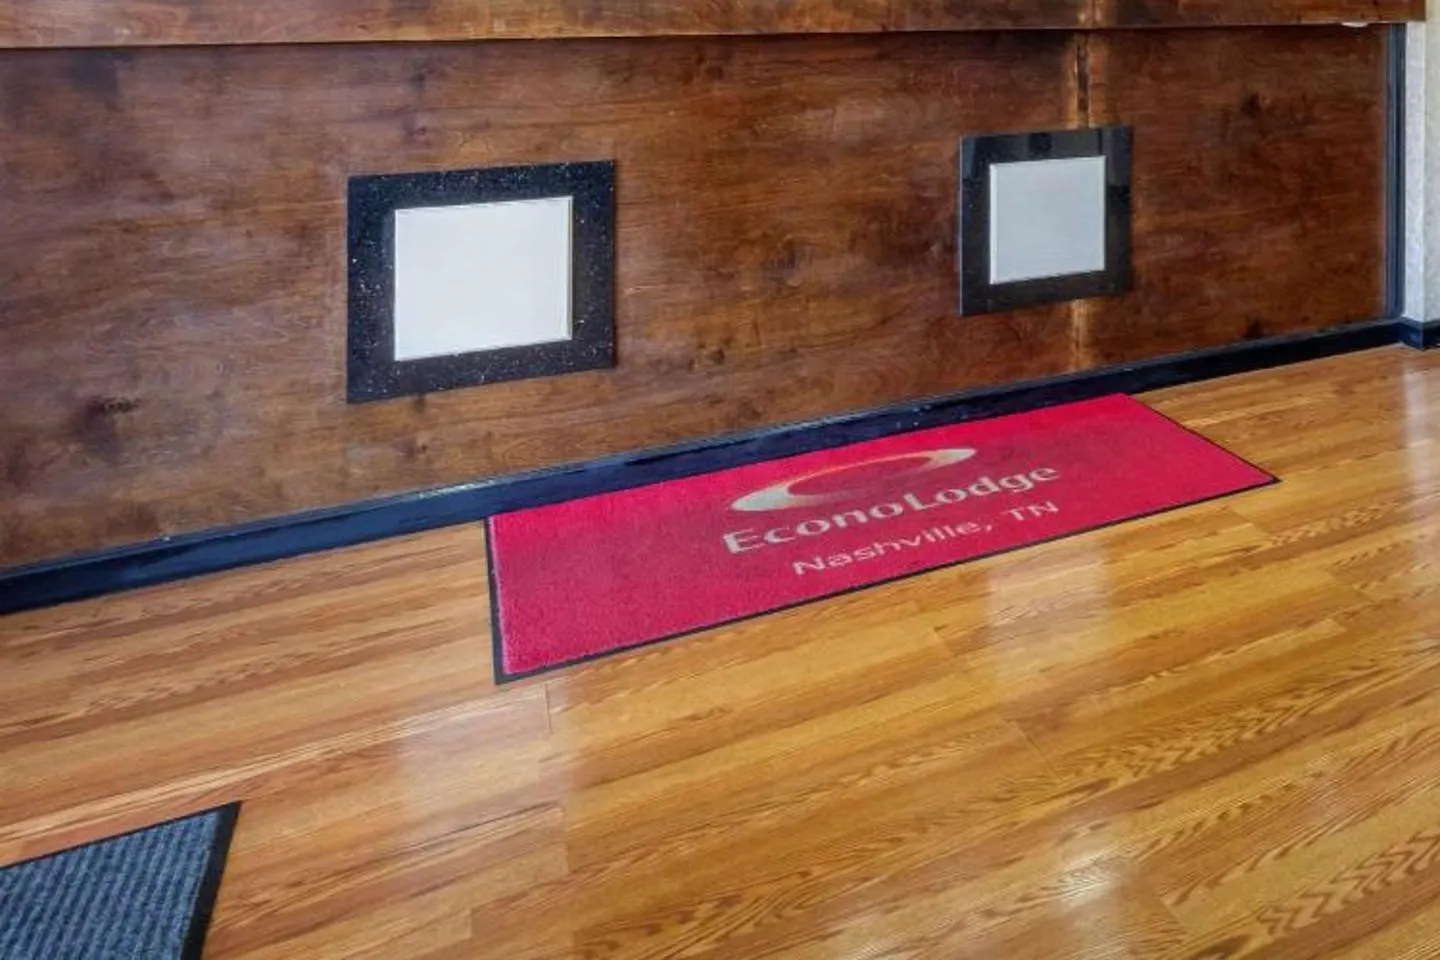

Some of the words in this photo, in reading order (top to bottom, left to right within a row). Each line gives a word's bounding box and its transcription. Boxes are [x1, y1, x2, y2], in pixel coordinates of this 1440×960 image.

[722, 466, 1061, 554] EconoLodge
[792, 522, 994, 575] Nashville,
[1003, 499, 1060, 522] TN
